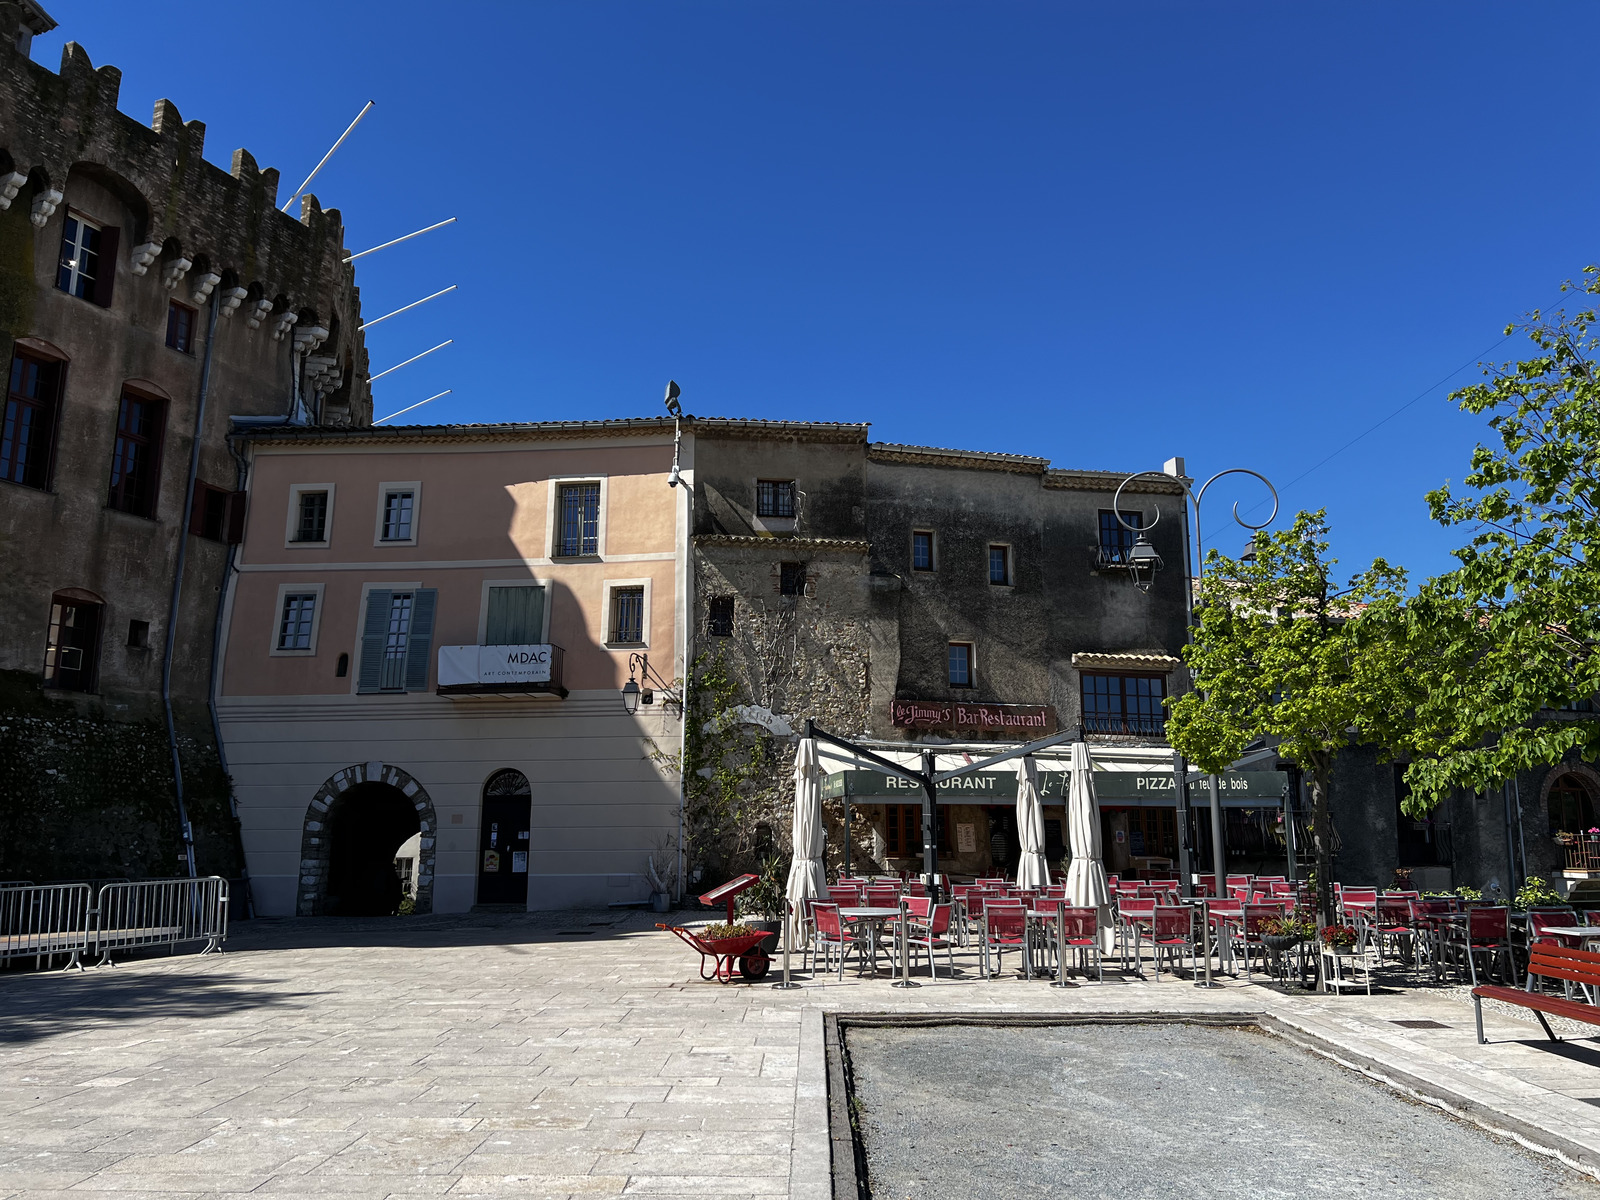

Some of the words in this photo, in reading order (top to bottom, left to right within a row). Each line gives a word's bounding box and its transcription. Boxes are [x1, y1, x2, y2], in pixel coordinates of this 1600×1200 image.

[507, 651, 547, 663] MDAC
[957, 707, 979, 724] Bar
[979, 708, 1047, 727] Restaurant
[886, 776, 997, 790] RESURANT
[1136, 777, 1176, 790] PIZZA
[1230, 777, 1248, 790] bois
